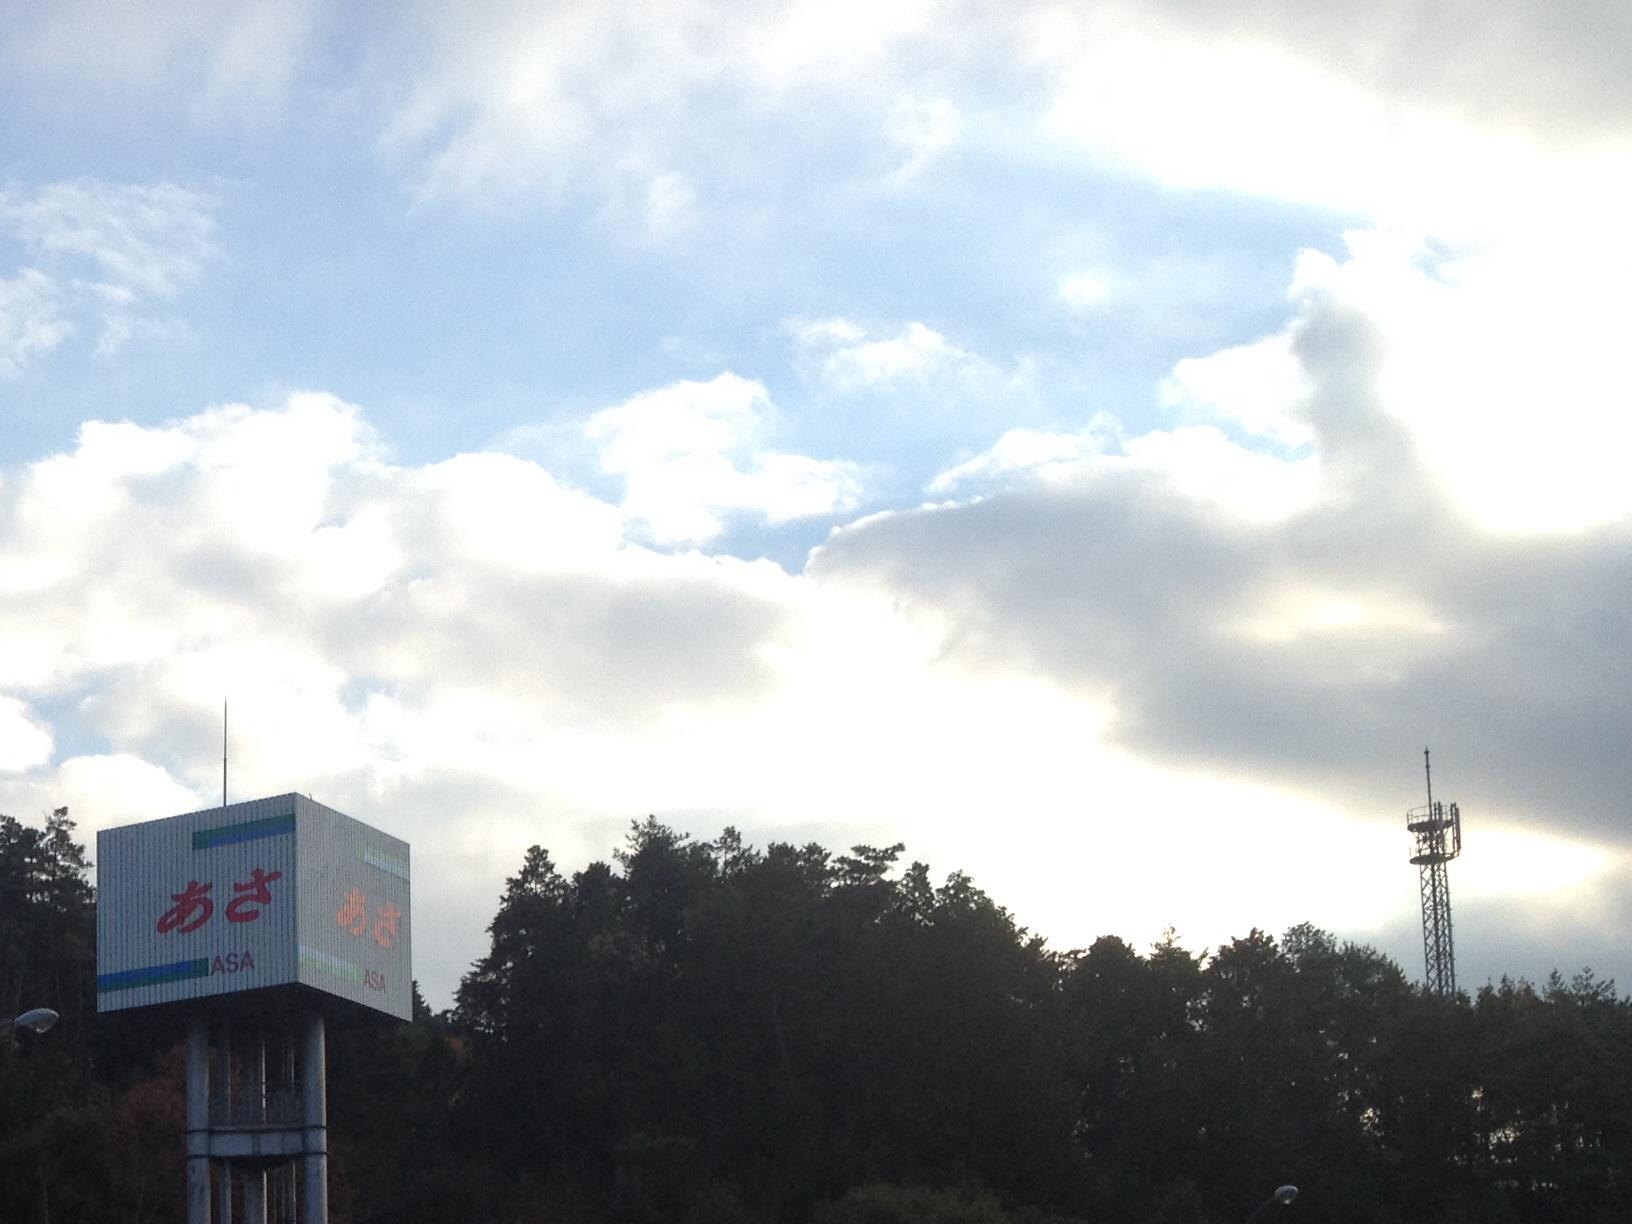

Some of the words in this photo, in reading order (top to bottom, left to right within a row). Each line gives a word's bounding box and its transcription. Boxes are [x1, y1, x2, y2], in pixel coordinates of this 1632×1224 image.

[156, 868, 282, 934] あさ
[336, 886, 401, 947] あさ
[211, 951, 255, 976] ASA
[364, 968, 386, 994] ASA
